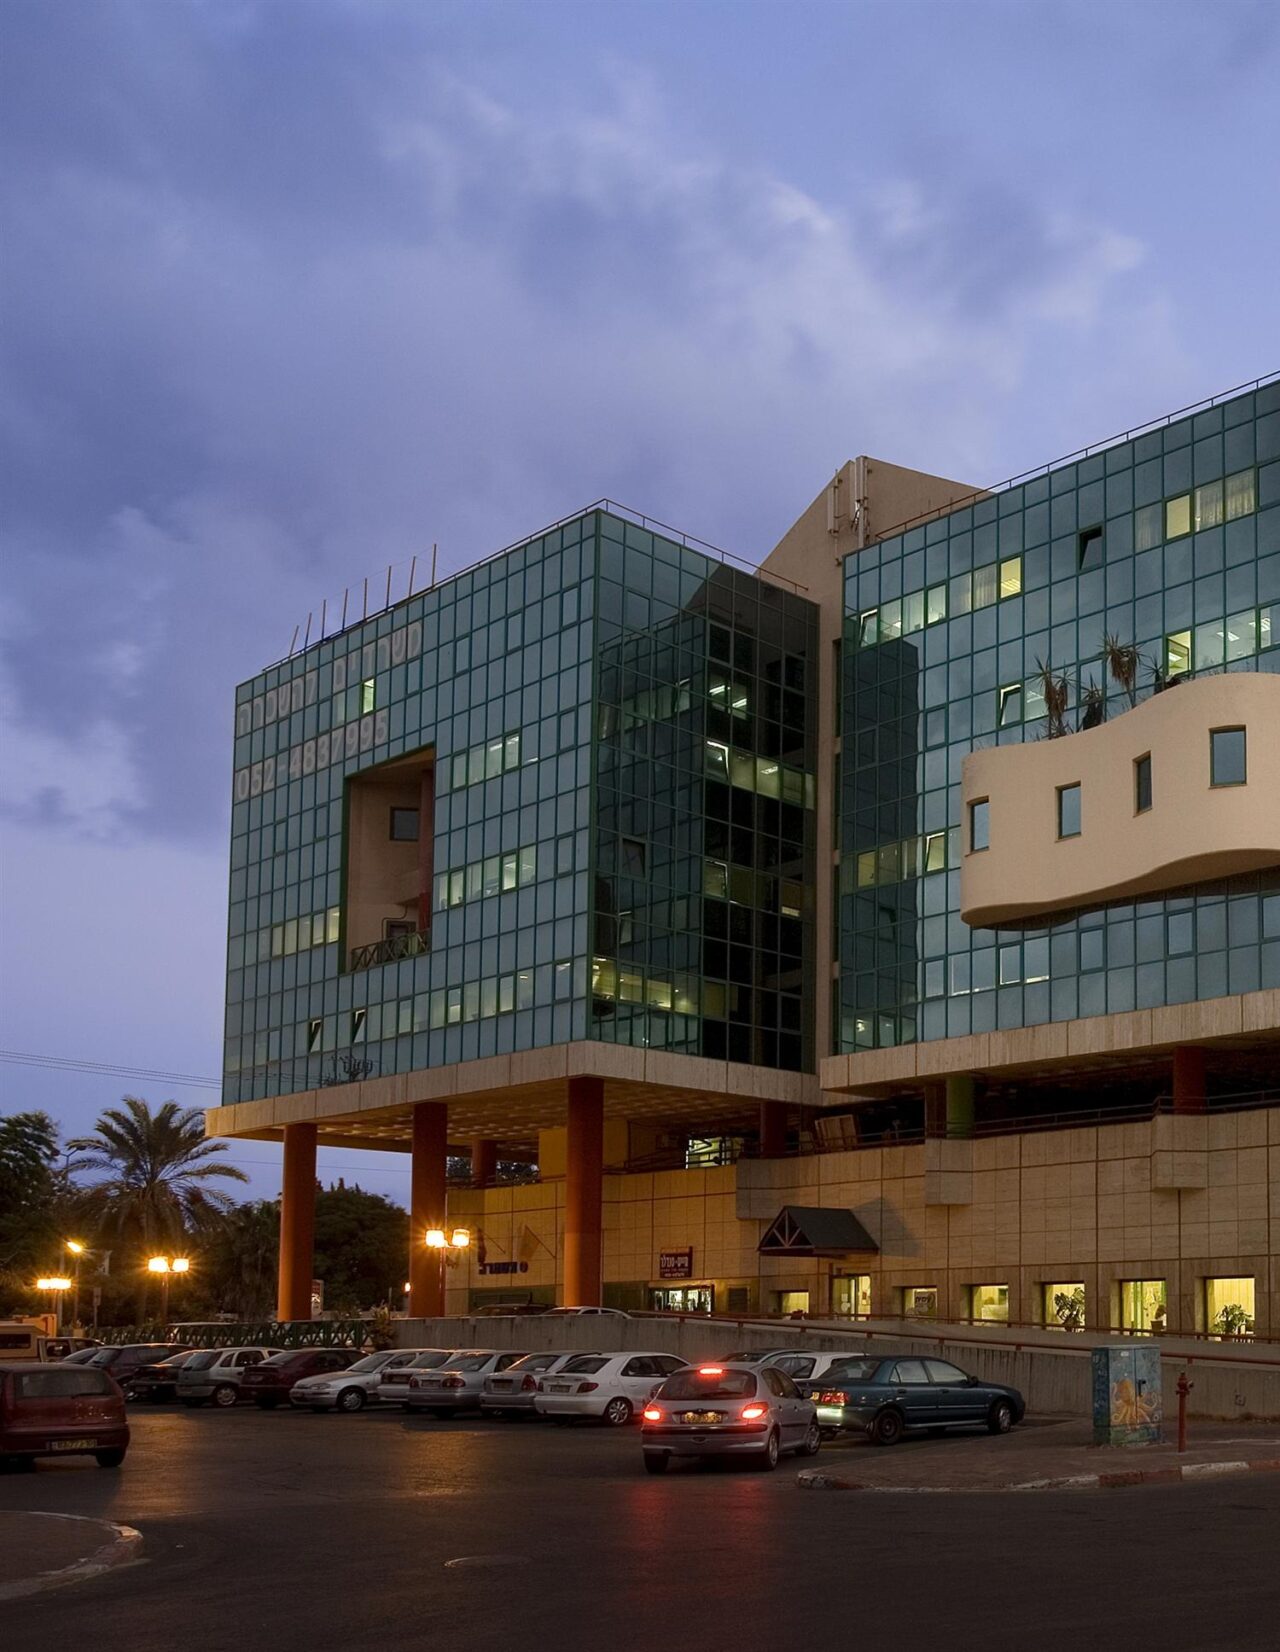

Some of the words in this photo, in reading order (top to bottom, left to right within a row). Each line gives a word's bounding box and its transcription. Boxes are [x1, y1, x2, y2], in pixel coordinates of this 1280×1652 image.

[334, 622, 422, 689] משרדים
[237, 664, 316, 736] להשכרה
[236, 710, 389, 799] 052-4837995
